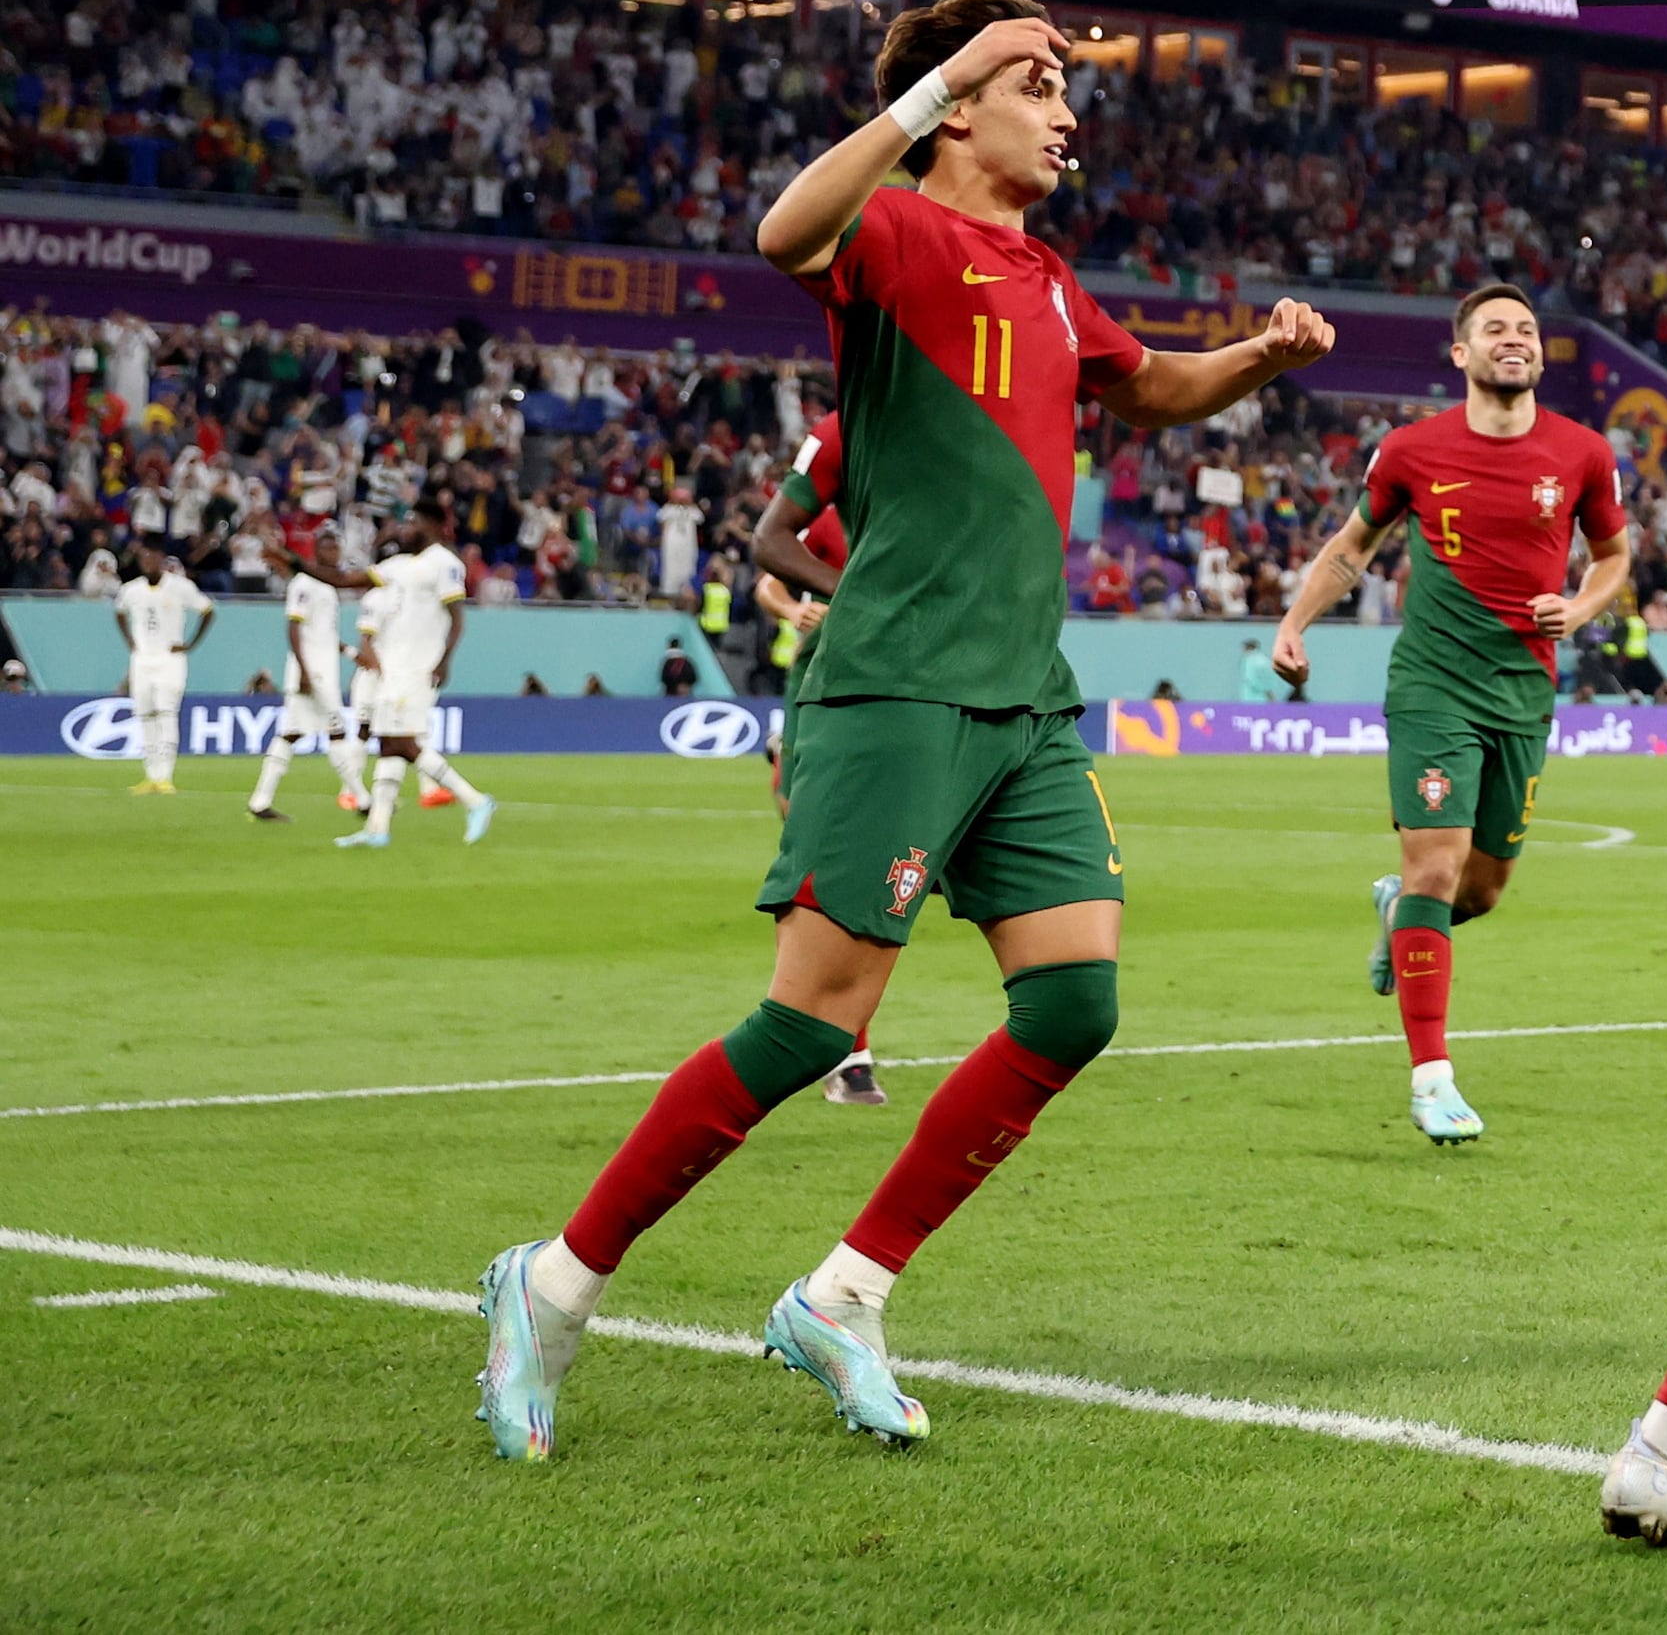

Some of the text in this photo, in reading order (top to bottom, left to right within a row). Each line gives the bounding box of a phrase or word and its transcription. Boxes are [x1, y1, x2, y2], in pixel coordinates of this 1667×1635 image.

[972, 314, 1012, 399] 11
[1441, 508, 1463, 557] 5
[1310, 717, 1389, 757] طر
[1520, 775, 1540, 826] 5
